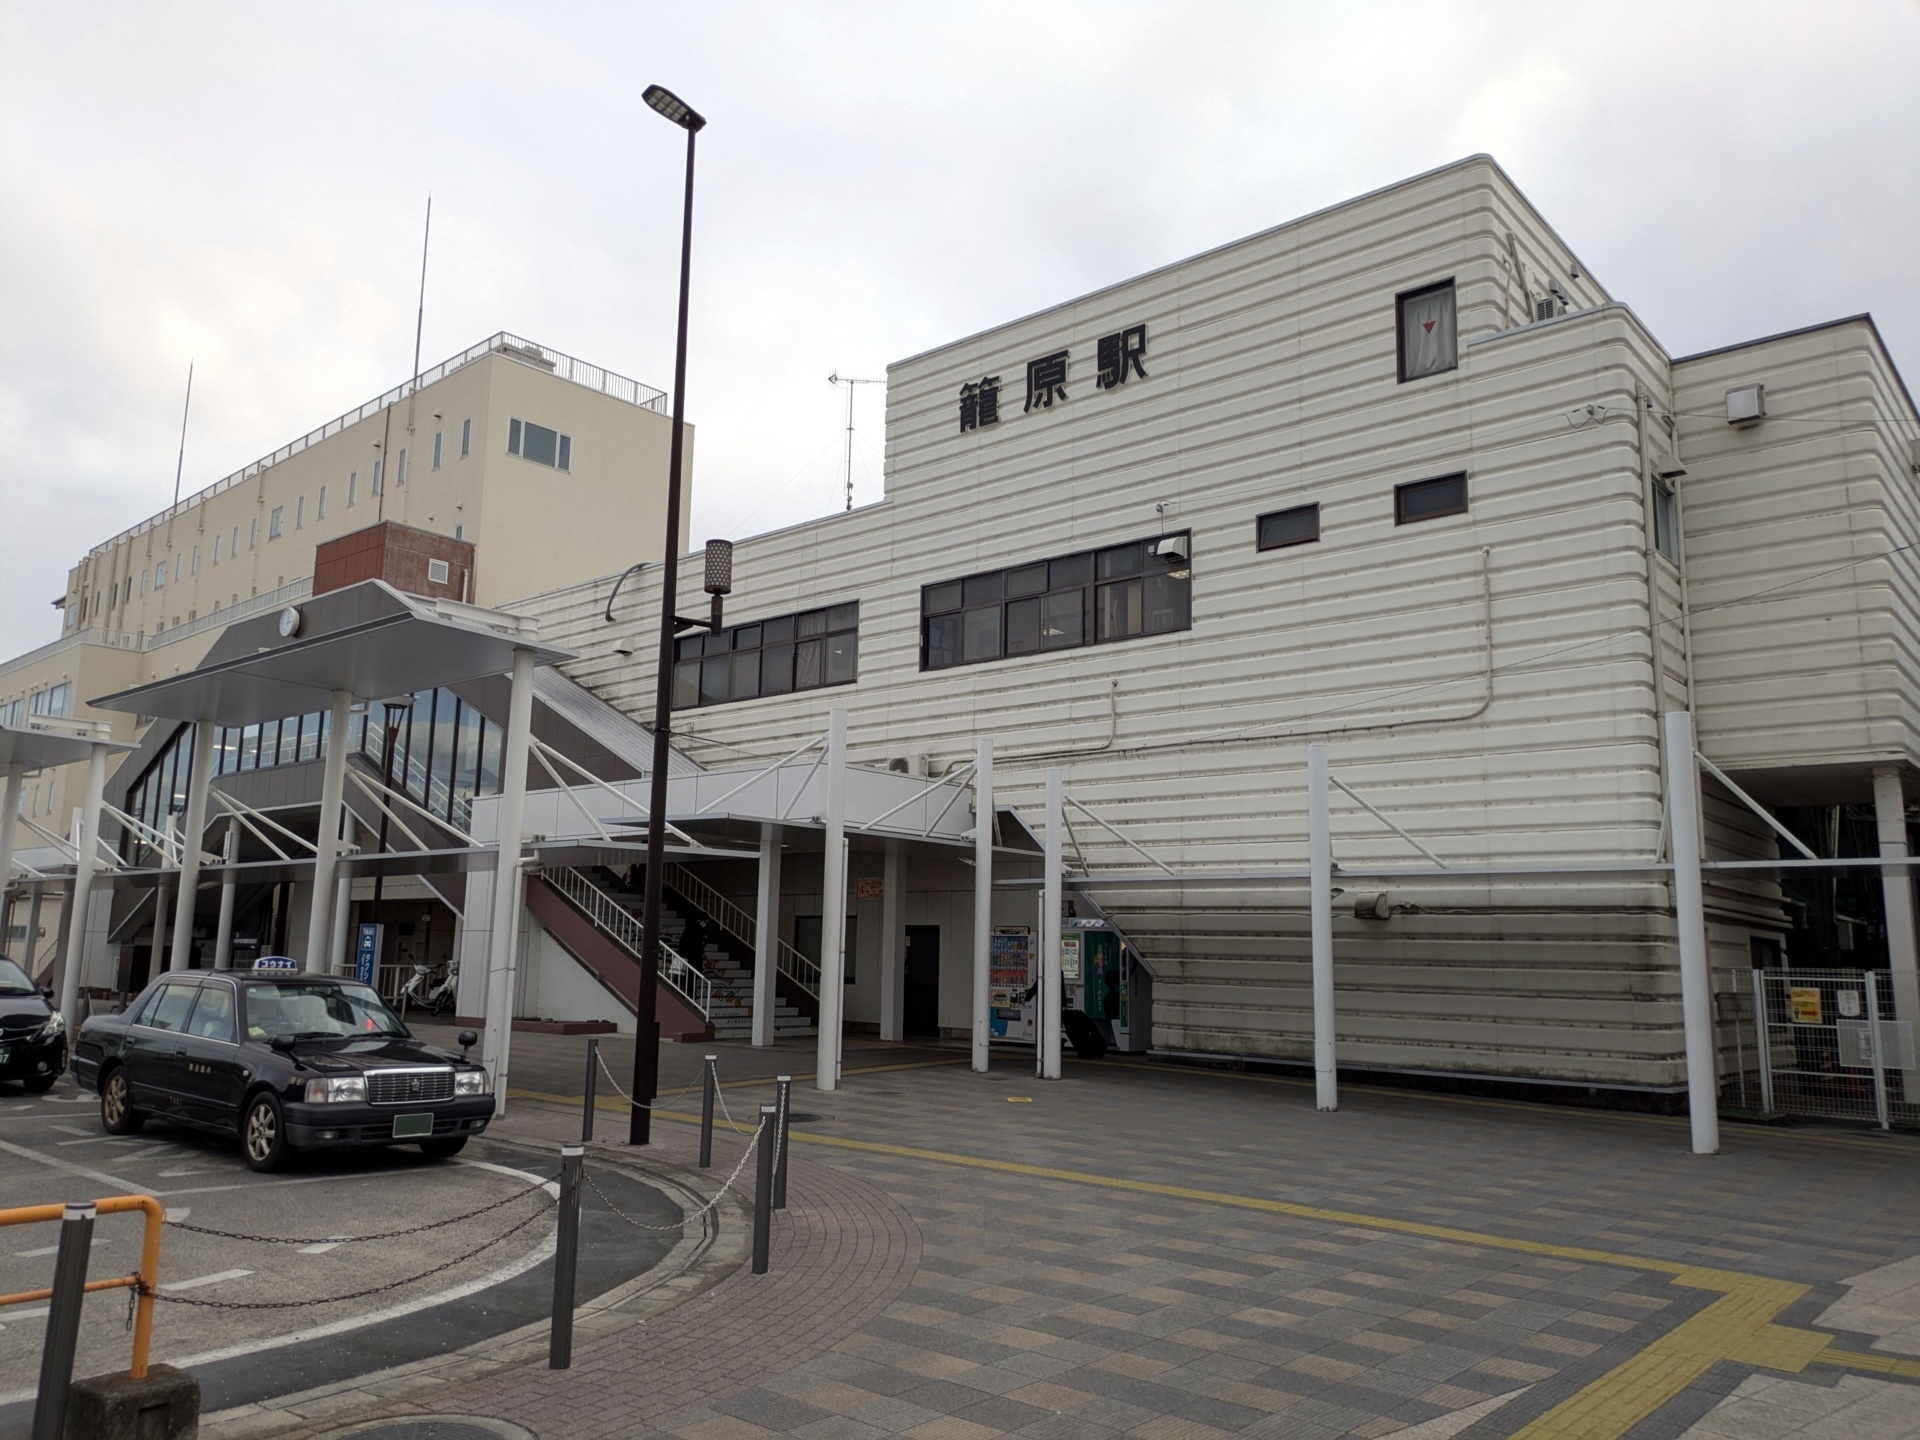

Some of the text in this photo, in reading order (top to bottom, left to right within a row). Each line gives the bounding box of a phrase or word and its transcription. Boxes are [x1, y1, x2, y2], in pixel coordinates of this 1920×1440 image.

[958, 323, 1149, 433] 籠原駅
[261, 960, 293, 969] コウナイ
[169, 1096, 183, 1105] TAXI
